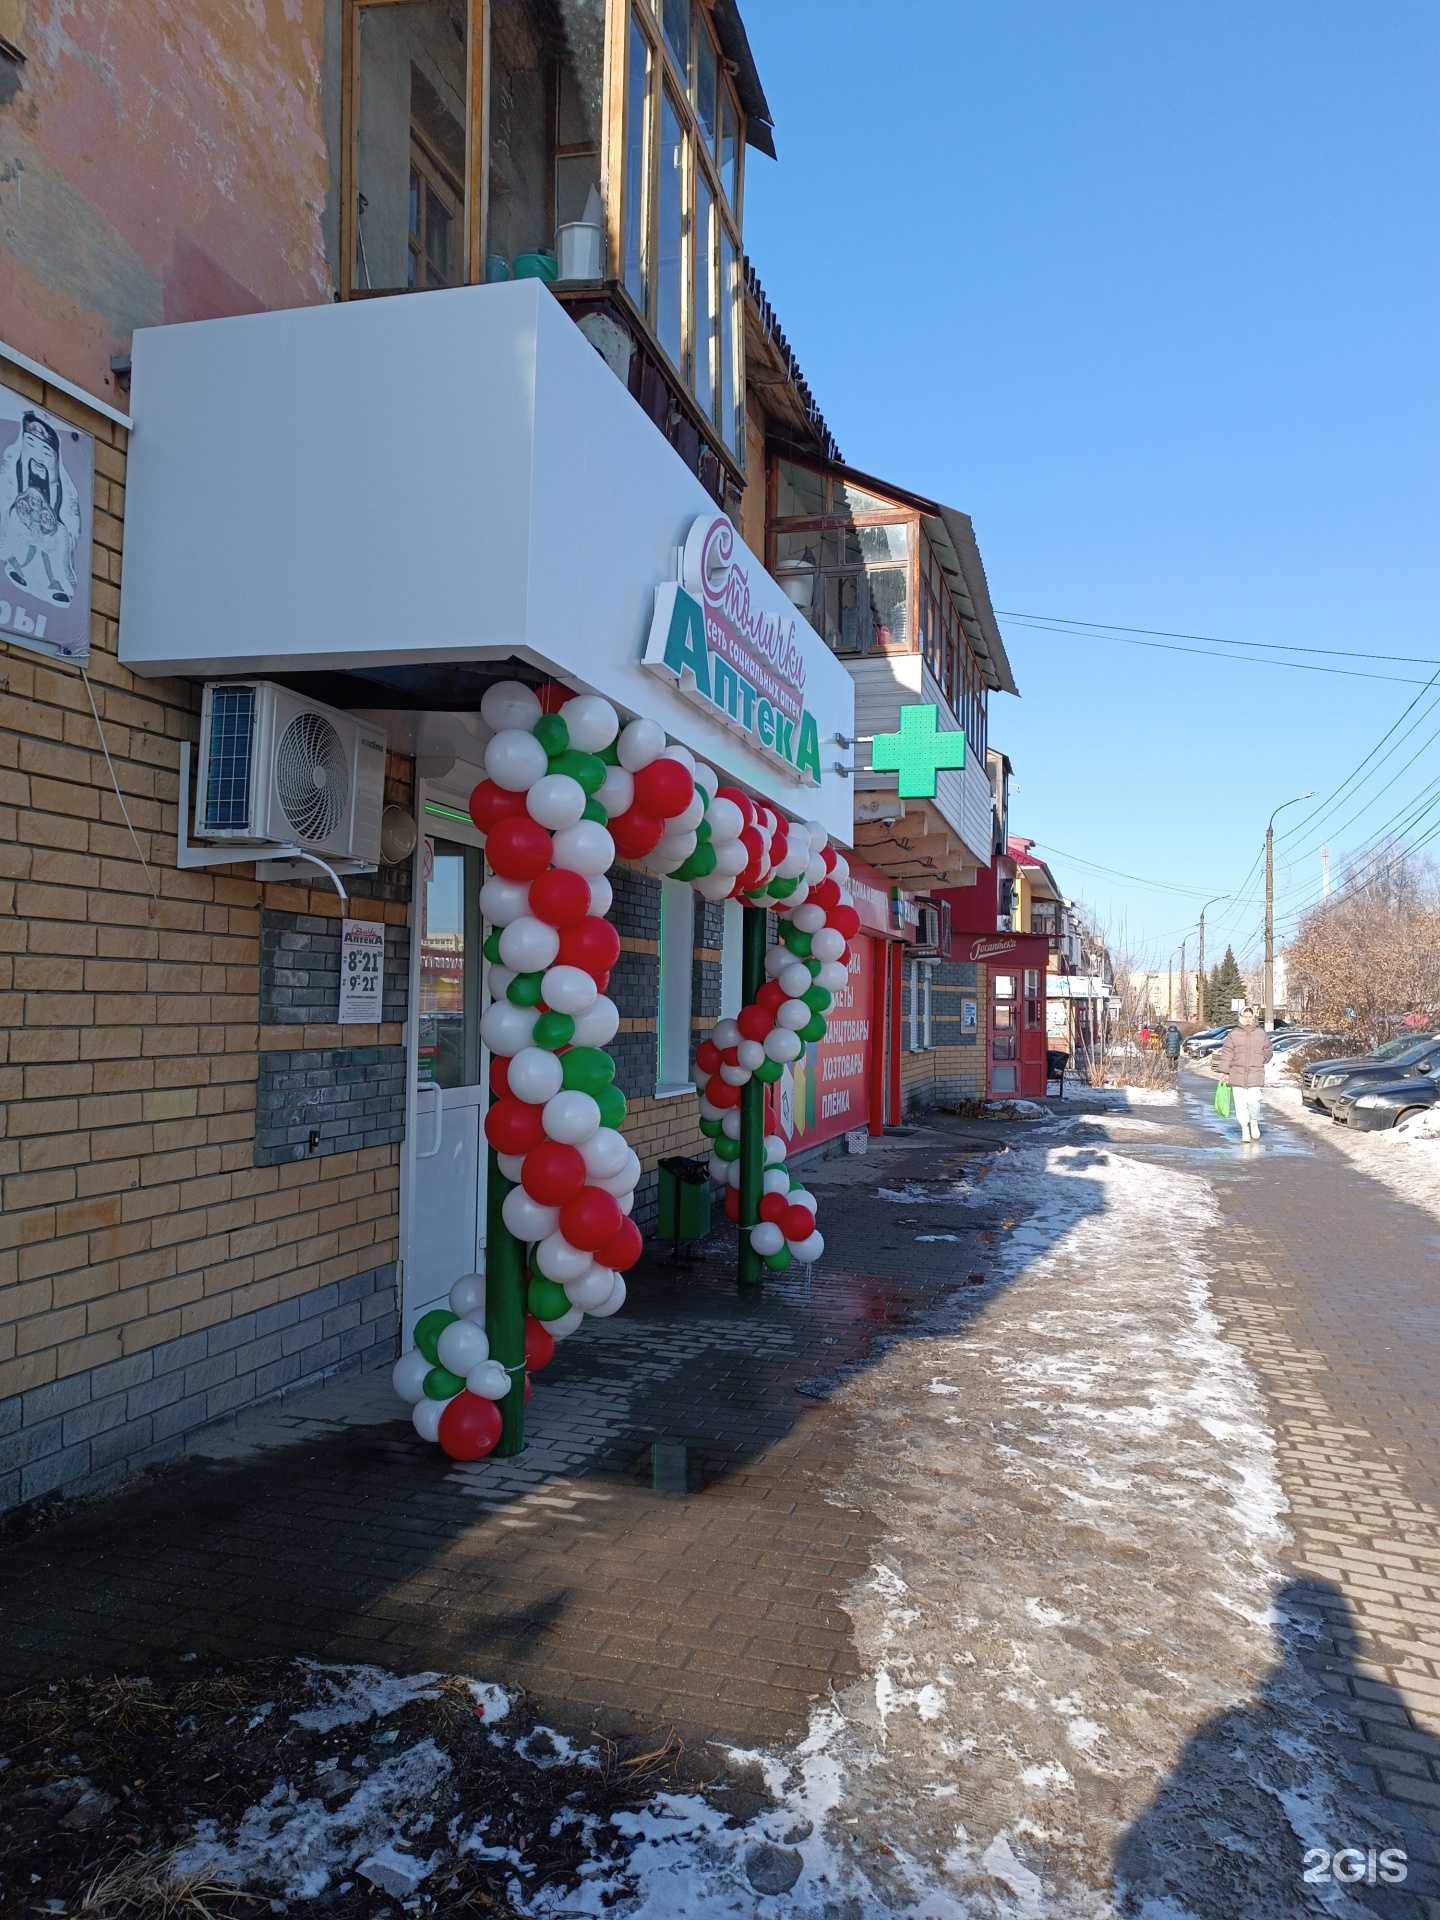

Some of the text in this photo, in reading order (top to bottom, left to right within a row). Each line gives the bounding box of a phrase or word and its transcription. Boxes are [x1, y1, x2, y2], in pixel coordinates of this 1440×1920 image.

[729, 640, 779, 701] социальных
[822, 1053, 864, 1081] ХОЗТОВАРЫ
[821, 1088, 850, 1120] ПЛЁНКА
